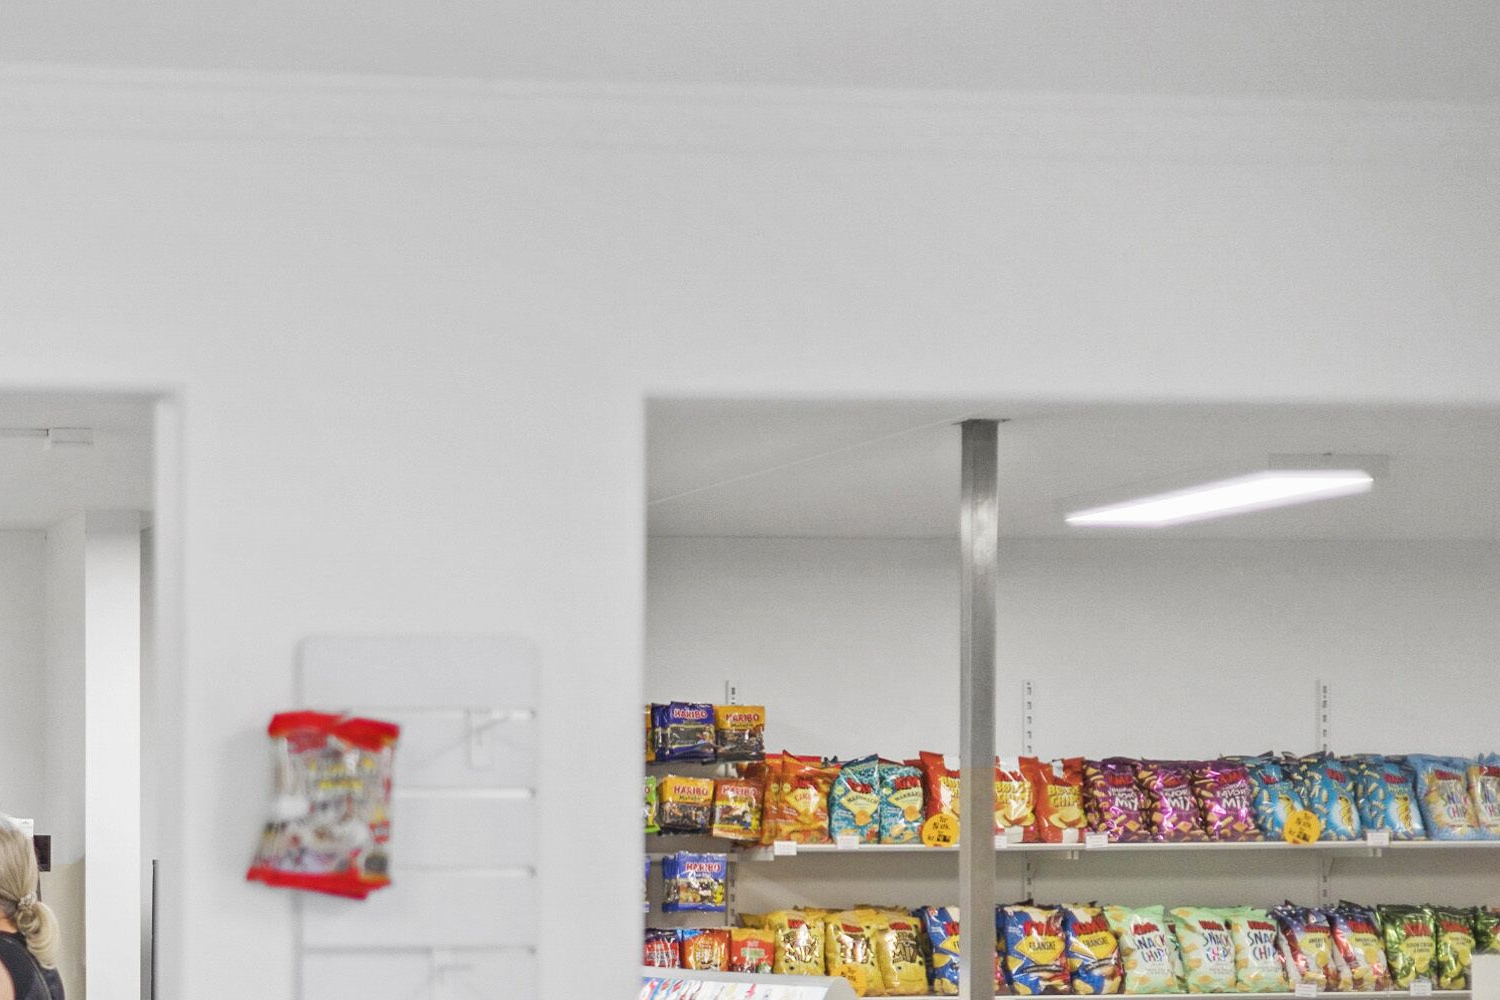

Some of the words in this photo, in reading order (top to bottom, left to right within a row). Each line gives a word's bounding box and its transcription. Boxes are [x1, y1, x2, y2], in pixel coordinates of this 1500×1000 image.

[673, 708, 708, 719] HARIBO
[725, 713, 760, 722] HARIBO
[674, 785, 709, 796] HARIBO
[722, 785, 758, 797] HARIBO
[1168, 796, 1193, 811] MIX
[1222, 796, 1248, 810] MIX
[686, 862, 721, 872] HARIBO
[1133, 934, 1166, 950] SNACK
[1142, 948, 1165, 963] CHIP
[1252, 945, 1278, 961] CHIP
